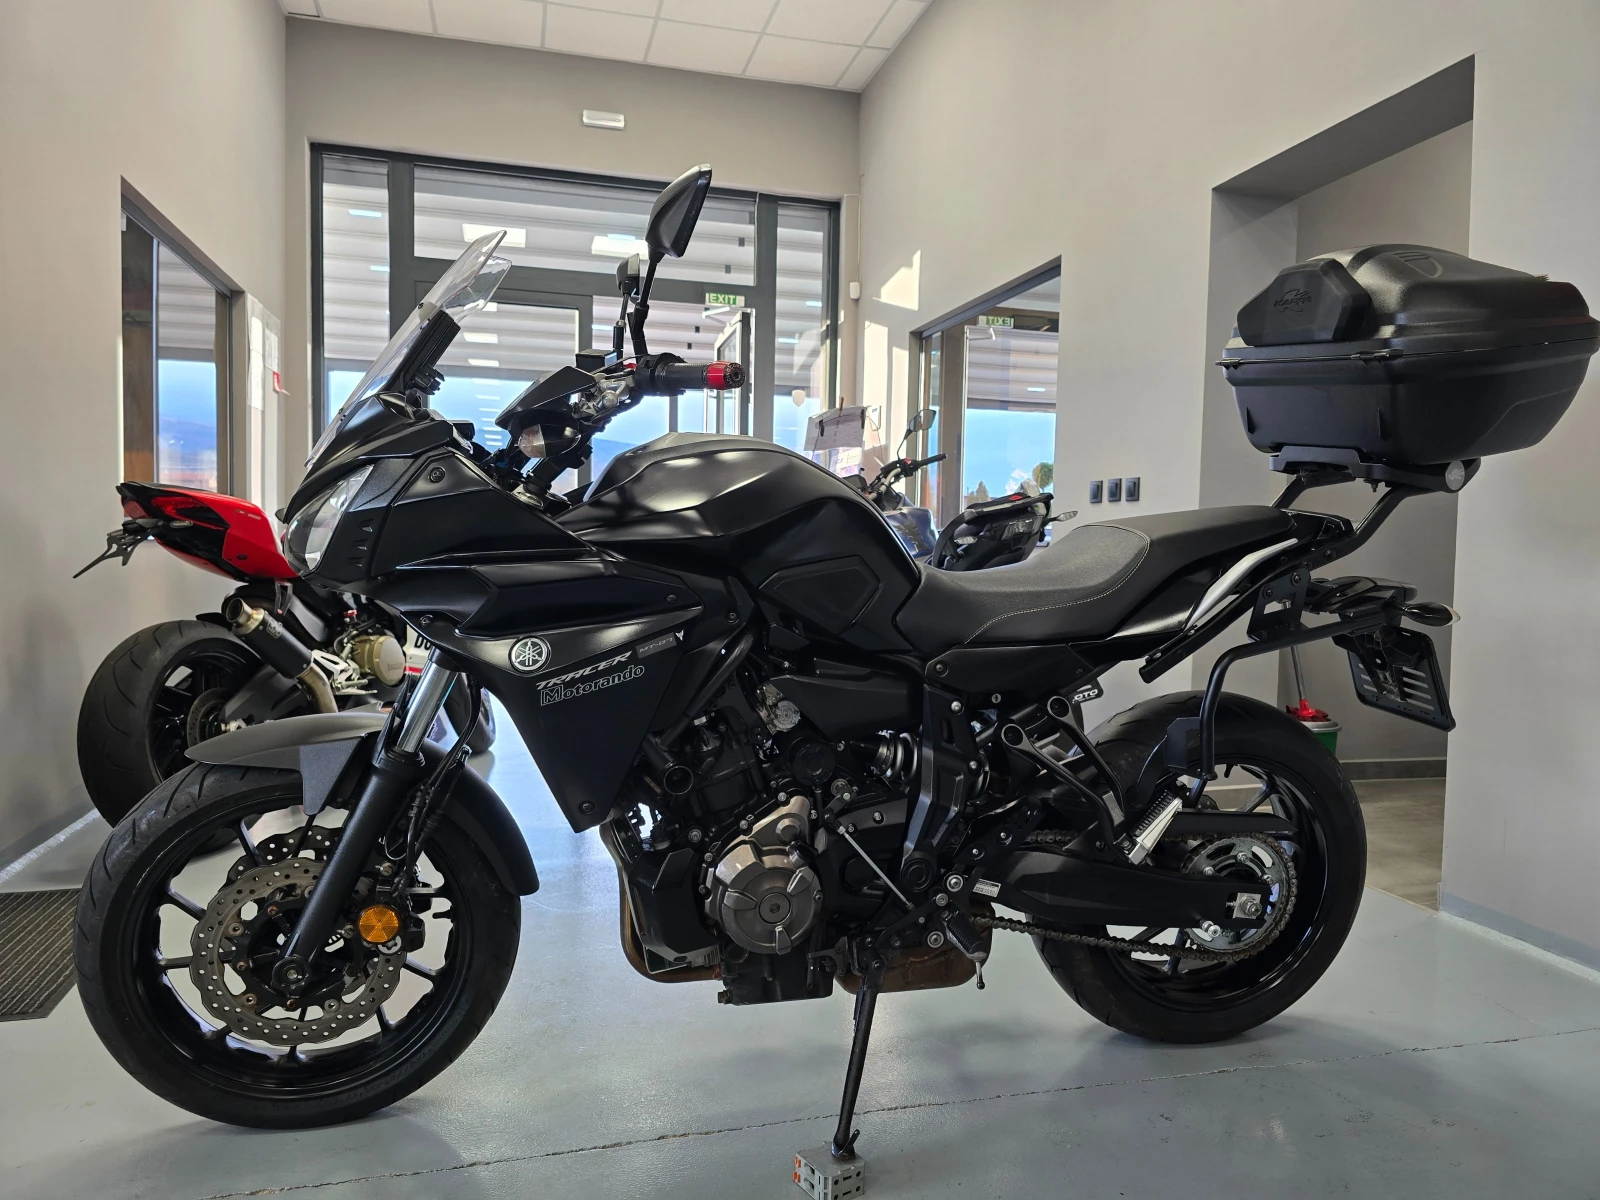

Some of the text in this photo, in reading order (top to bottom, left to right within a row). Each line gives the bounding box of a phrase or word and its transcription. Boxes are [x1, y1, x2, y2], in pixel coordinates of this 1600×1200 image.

[709, 293, 735, 305] EXIT
[536, 651, 632, 690] TRACER
[541, 665, 645, 706] Motorando
